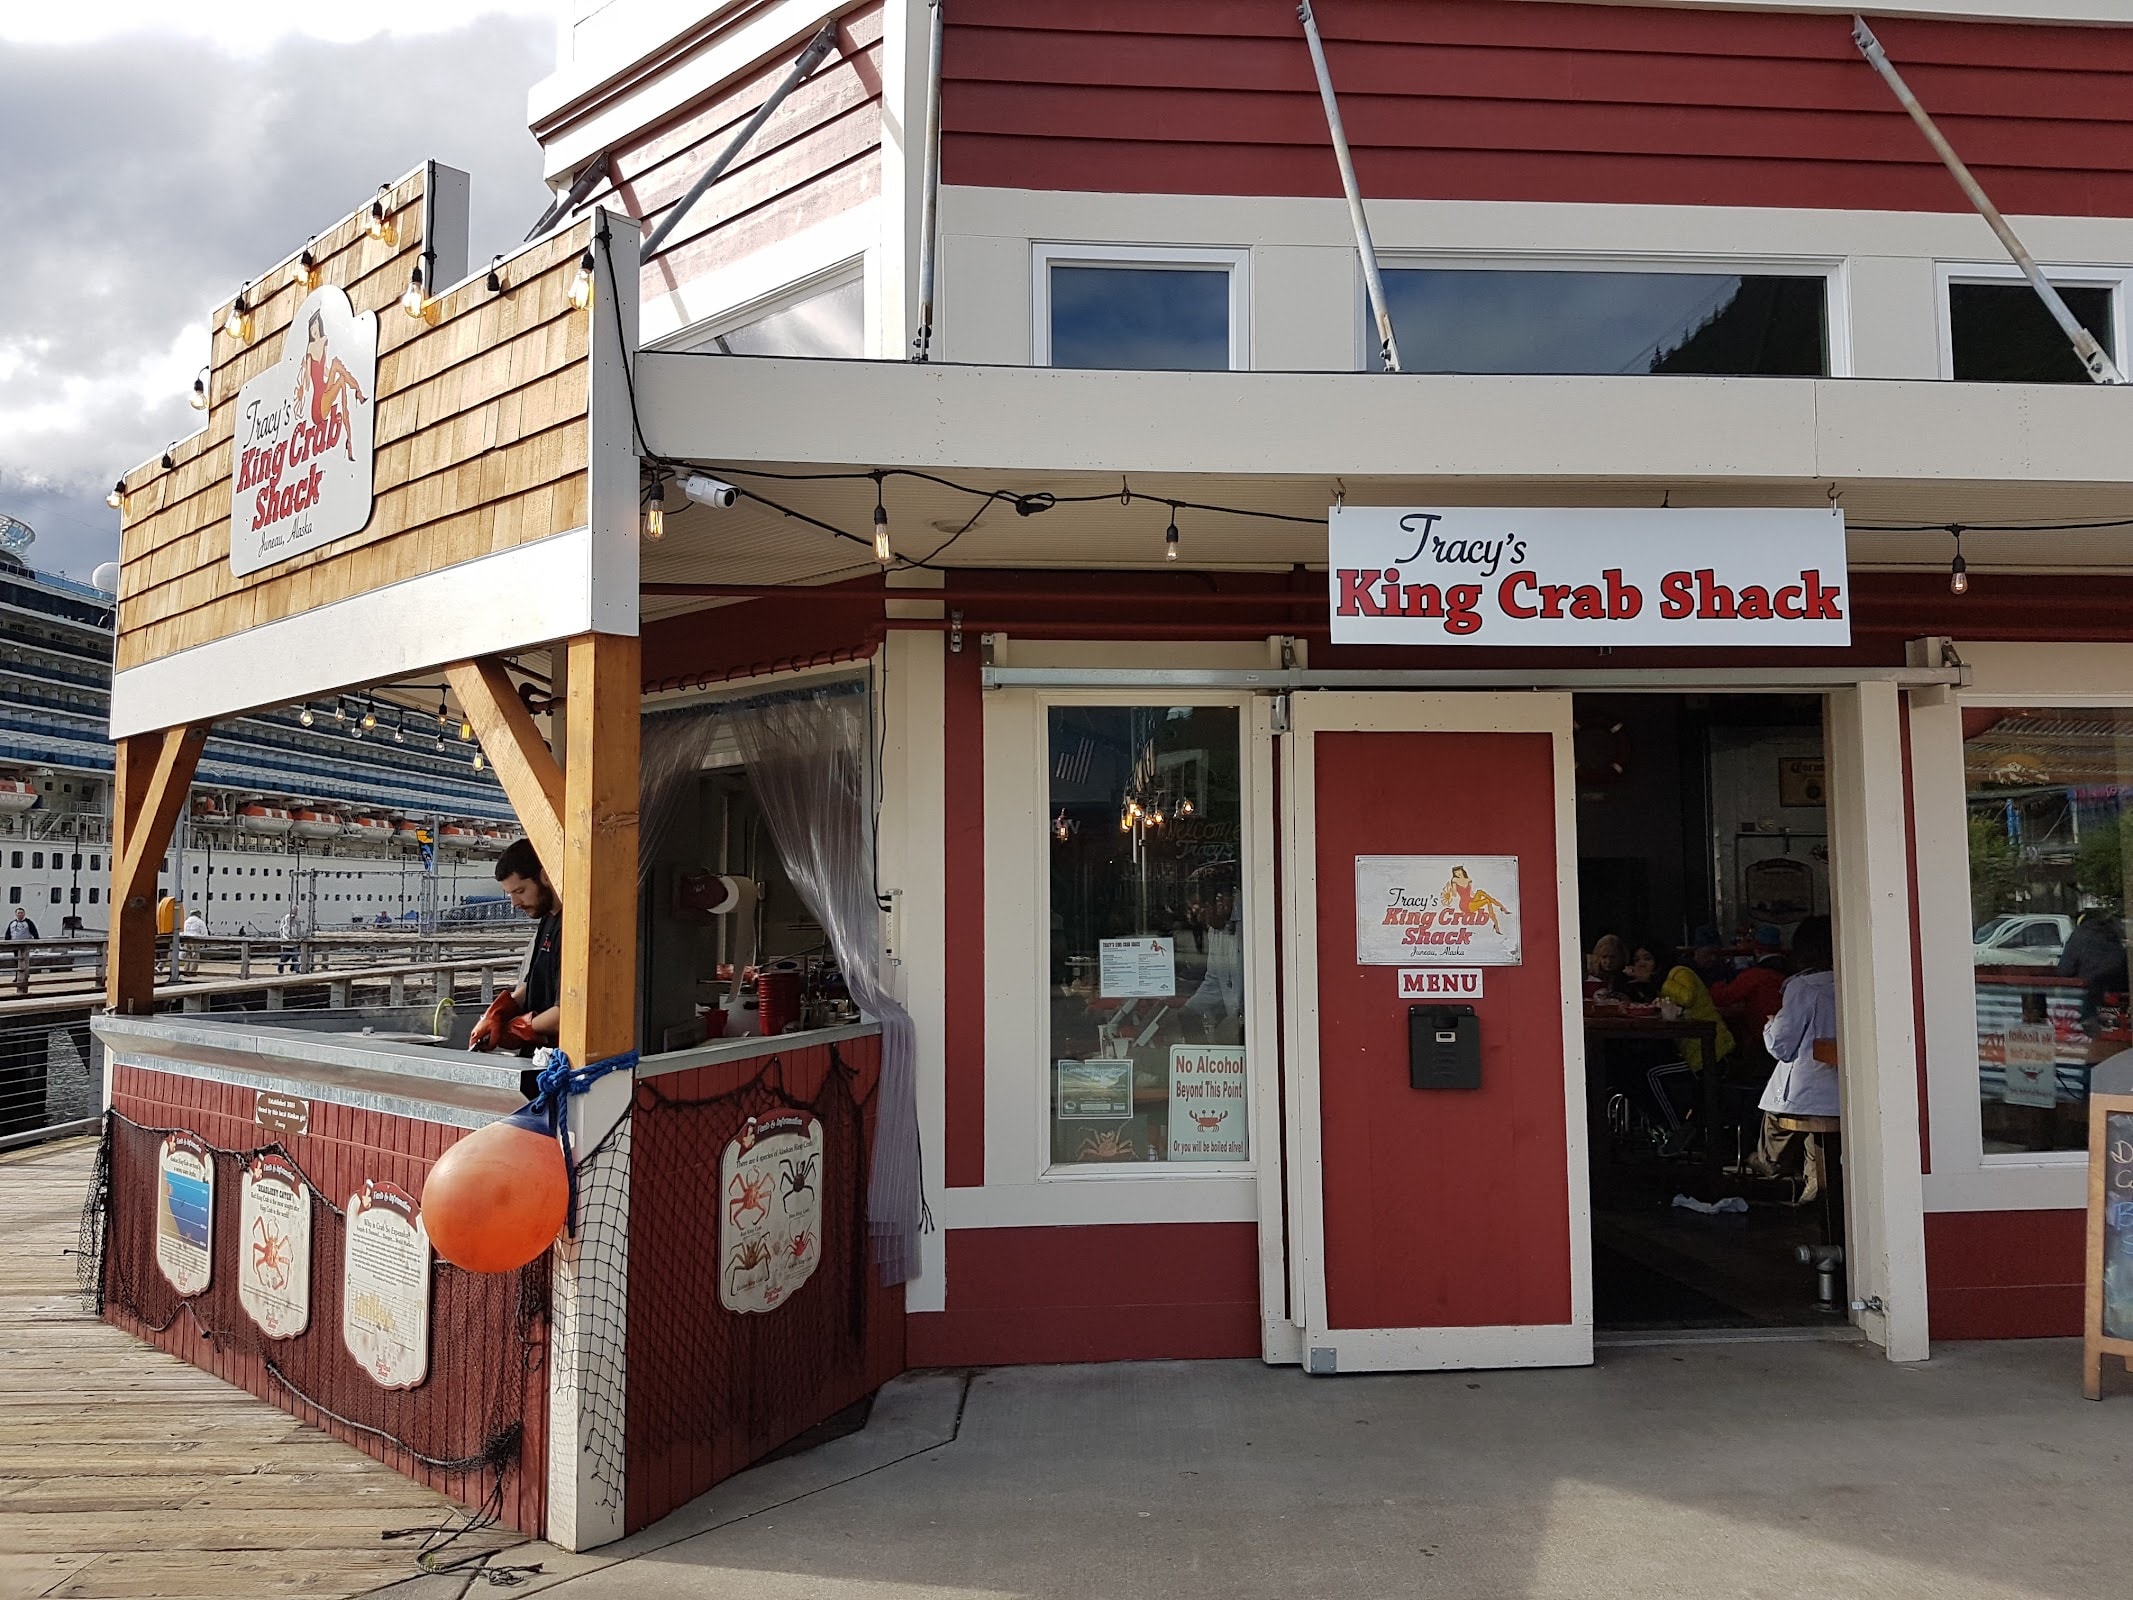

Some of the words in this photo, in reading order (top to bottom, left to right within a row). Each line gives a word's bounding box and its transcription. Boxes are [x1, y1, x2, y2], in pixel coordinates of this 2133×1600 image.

[243, 399, 291, 449] Tracy's
[236, 438, 288, 494] King
[289, 404, 342, 469] Crab
[251, 463, 324, 532] Shack
[258, 529, 285, 558] Juneau,
[286, 513, 313, 544] Alaska
[1394, 512, 1527, 577] Tracy's
[1336, 568, 1483, 636] King
[1497, 569, 1643, 621] Crab
[1660, 568, 1843, 621] Shack
[1386, 887, 1439, 912] Tracy's
[1382, 907, 1435, 931] King
[1438, 907, 1490, 926] Crab
[1401, 926, 1473, 945] Shack
[1403, 974, 1478, 992] MENU
[1176, 1055, 1192, 1073] No
[1196, 1056, 1243, 1074] Alcohol
[1176, 1080, 1203, 1102] Beyond
[1205, 1081, 1220, 1098] This
[1223, 1081, 1242, 1098] Point
[1203, 1141, 1210, 1152] be
[1211, 1141, 1227, 1152] boiled
